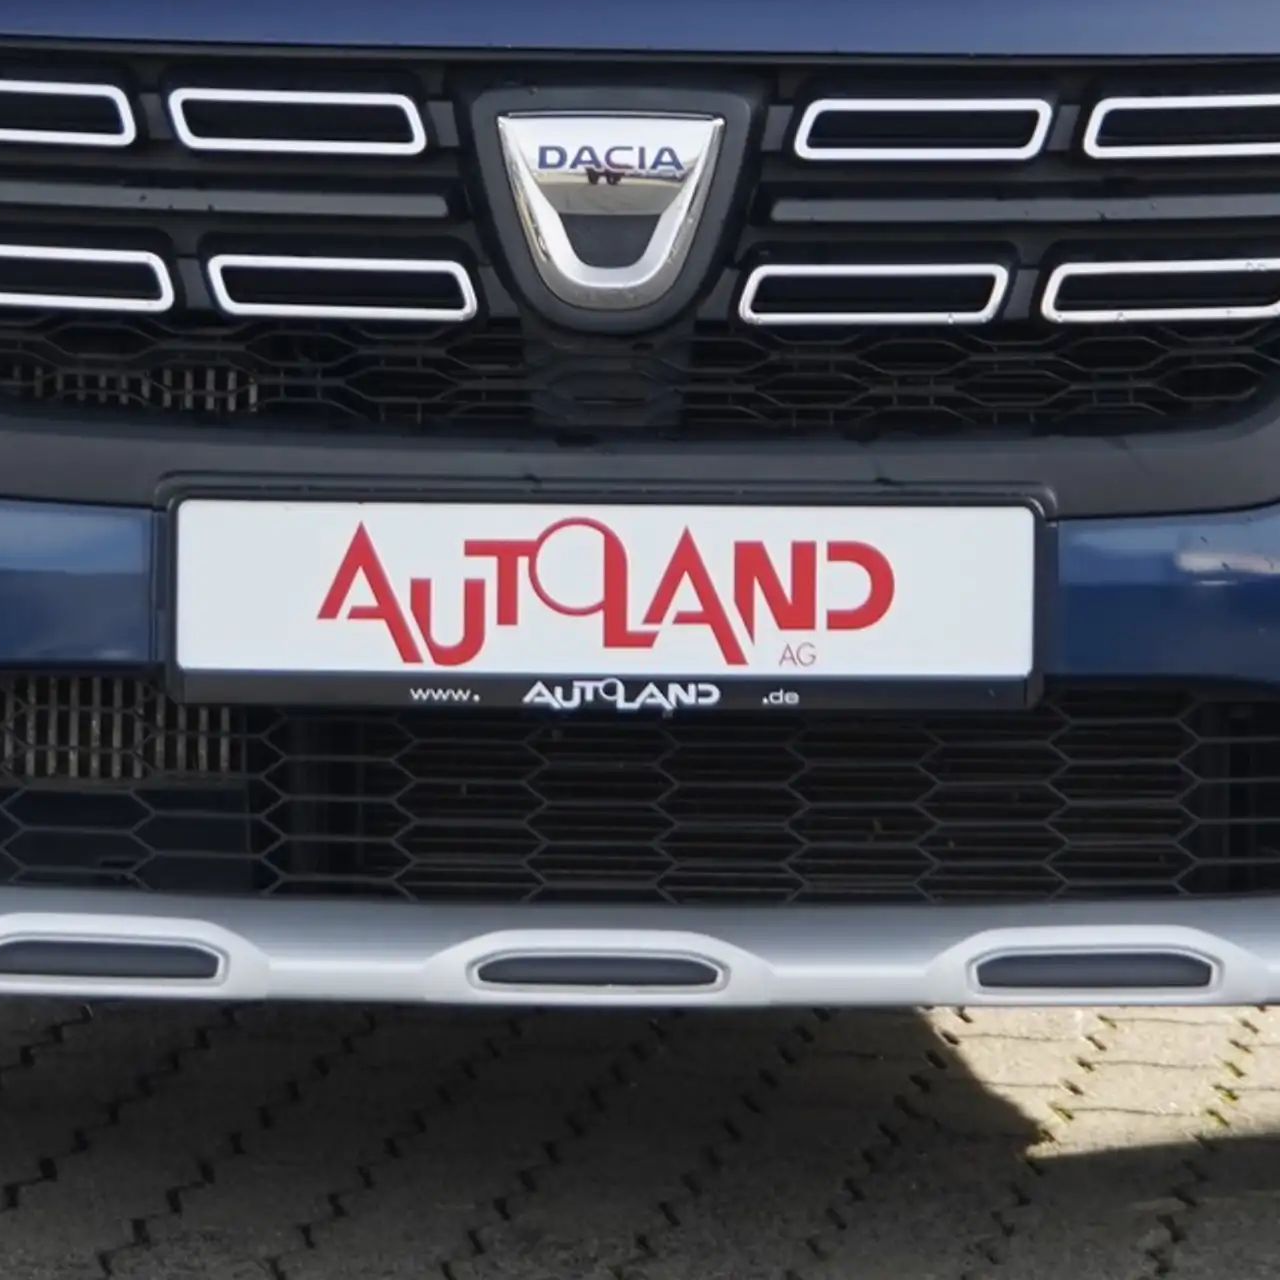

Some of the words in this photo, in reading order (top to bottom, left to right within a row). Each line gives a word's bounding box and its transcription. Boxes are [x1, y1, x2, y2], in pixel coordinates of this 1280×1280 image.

[537, 144, 685, 171] DACIA
[317, 516, 896, 667] AUTOLAND
[777, 643, 818, 668] AG
[522, 677, 721, 711] AUTOLAND
